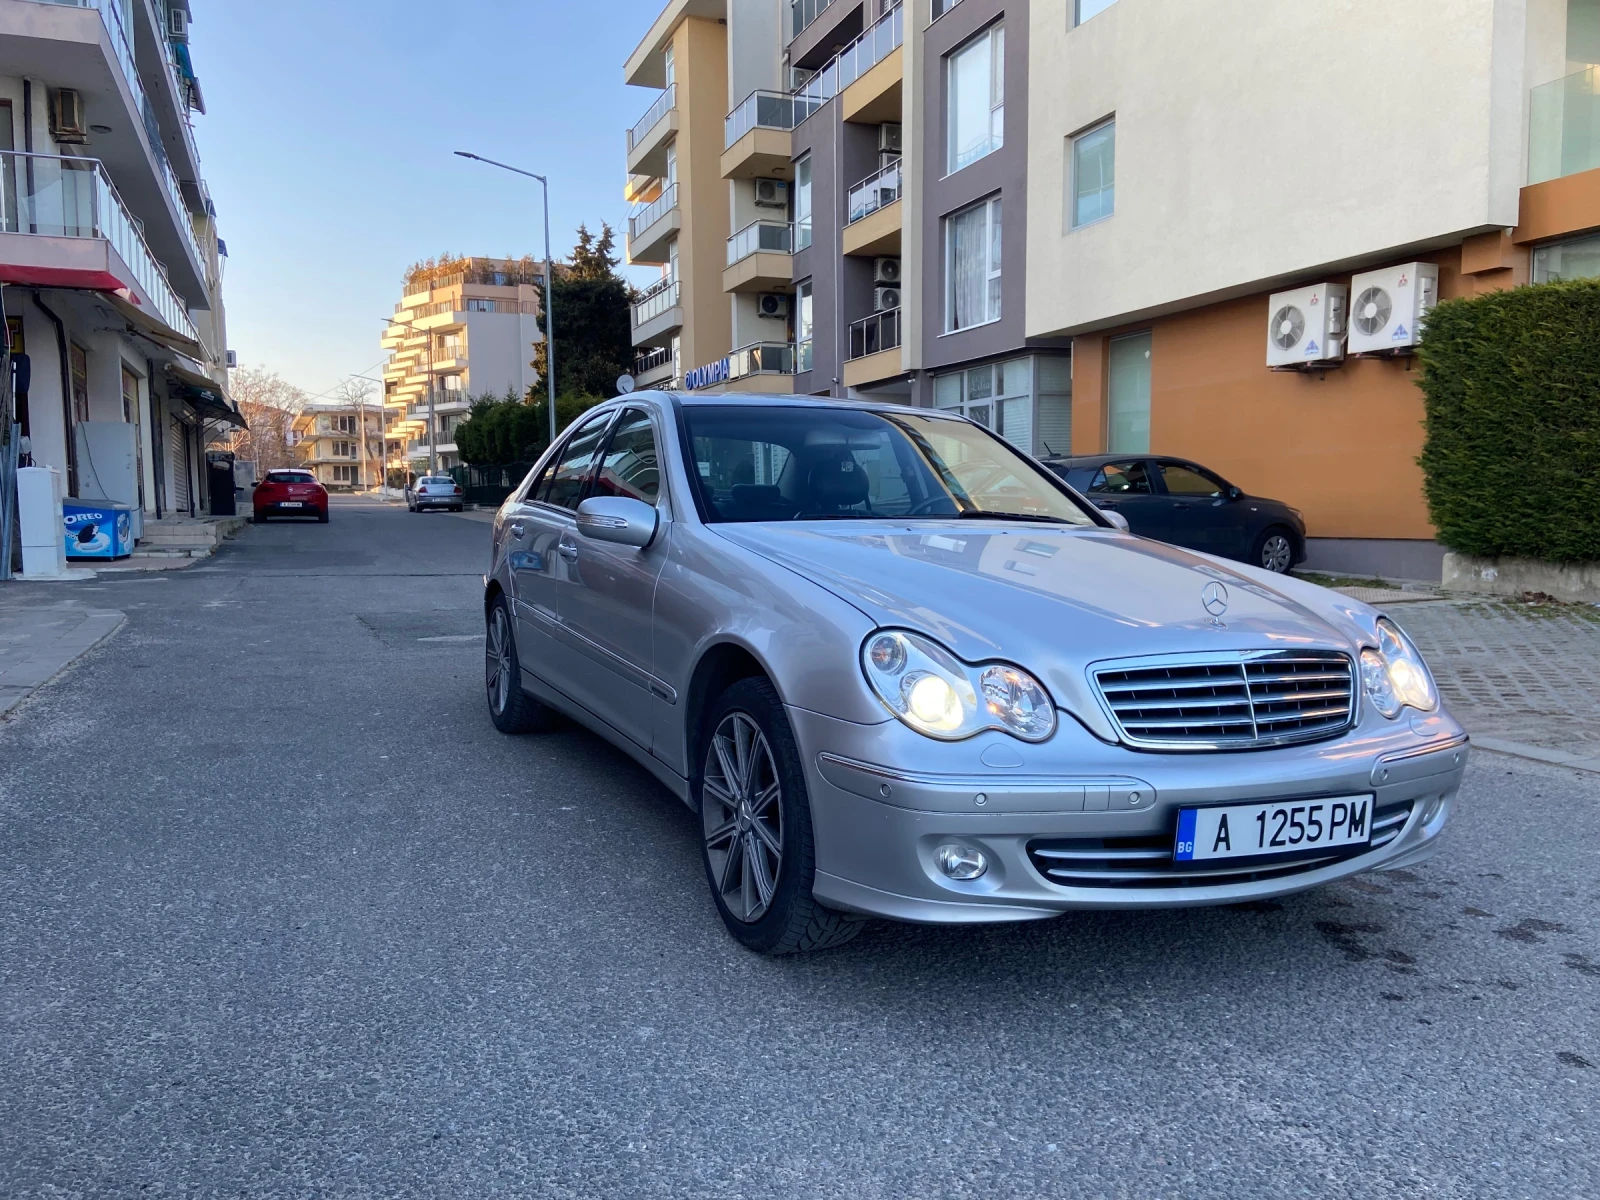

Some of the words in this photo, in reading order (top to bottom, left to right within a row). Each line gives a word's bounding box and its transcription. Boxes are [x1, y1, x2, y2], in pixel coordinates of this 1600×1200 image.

[692, 358, 729, 388] OLYMPIA
[63, 513, 102, 524] OREO
[1212, 813, 1231, 852] A
[1177, 841, 1193, 854] BG
